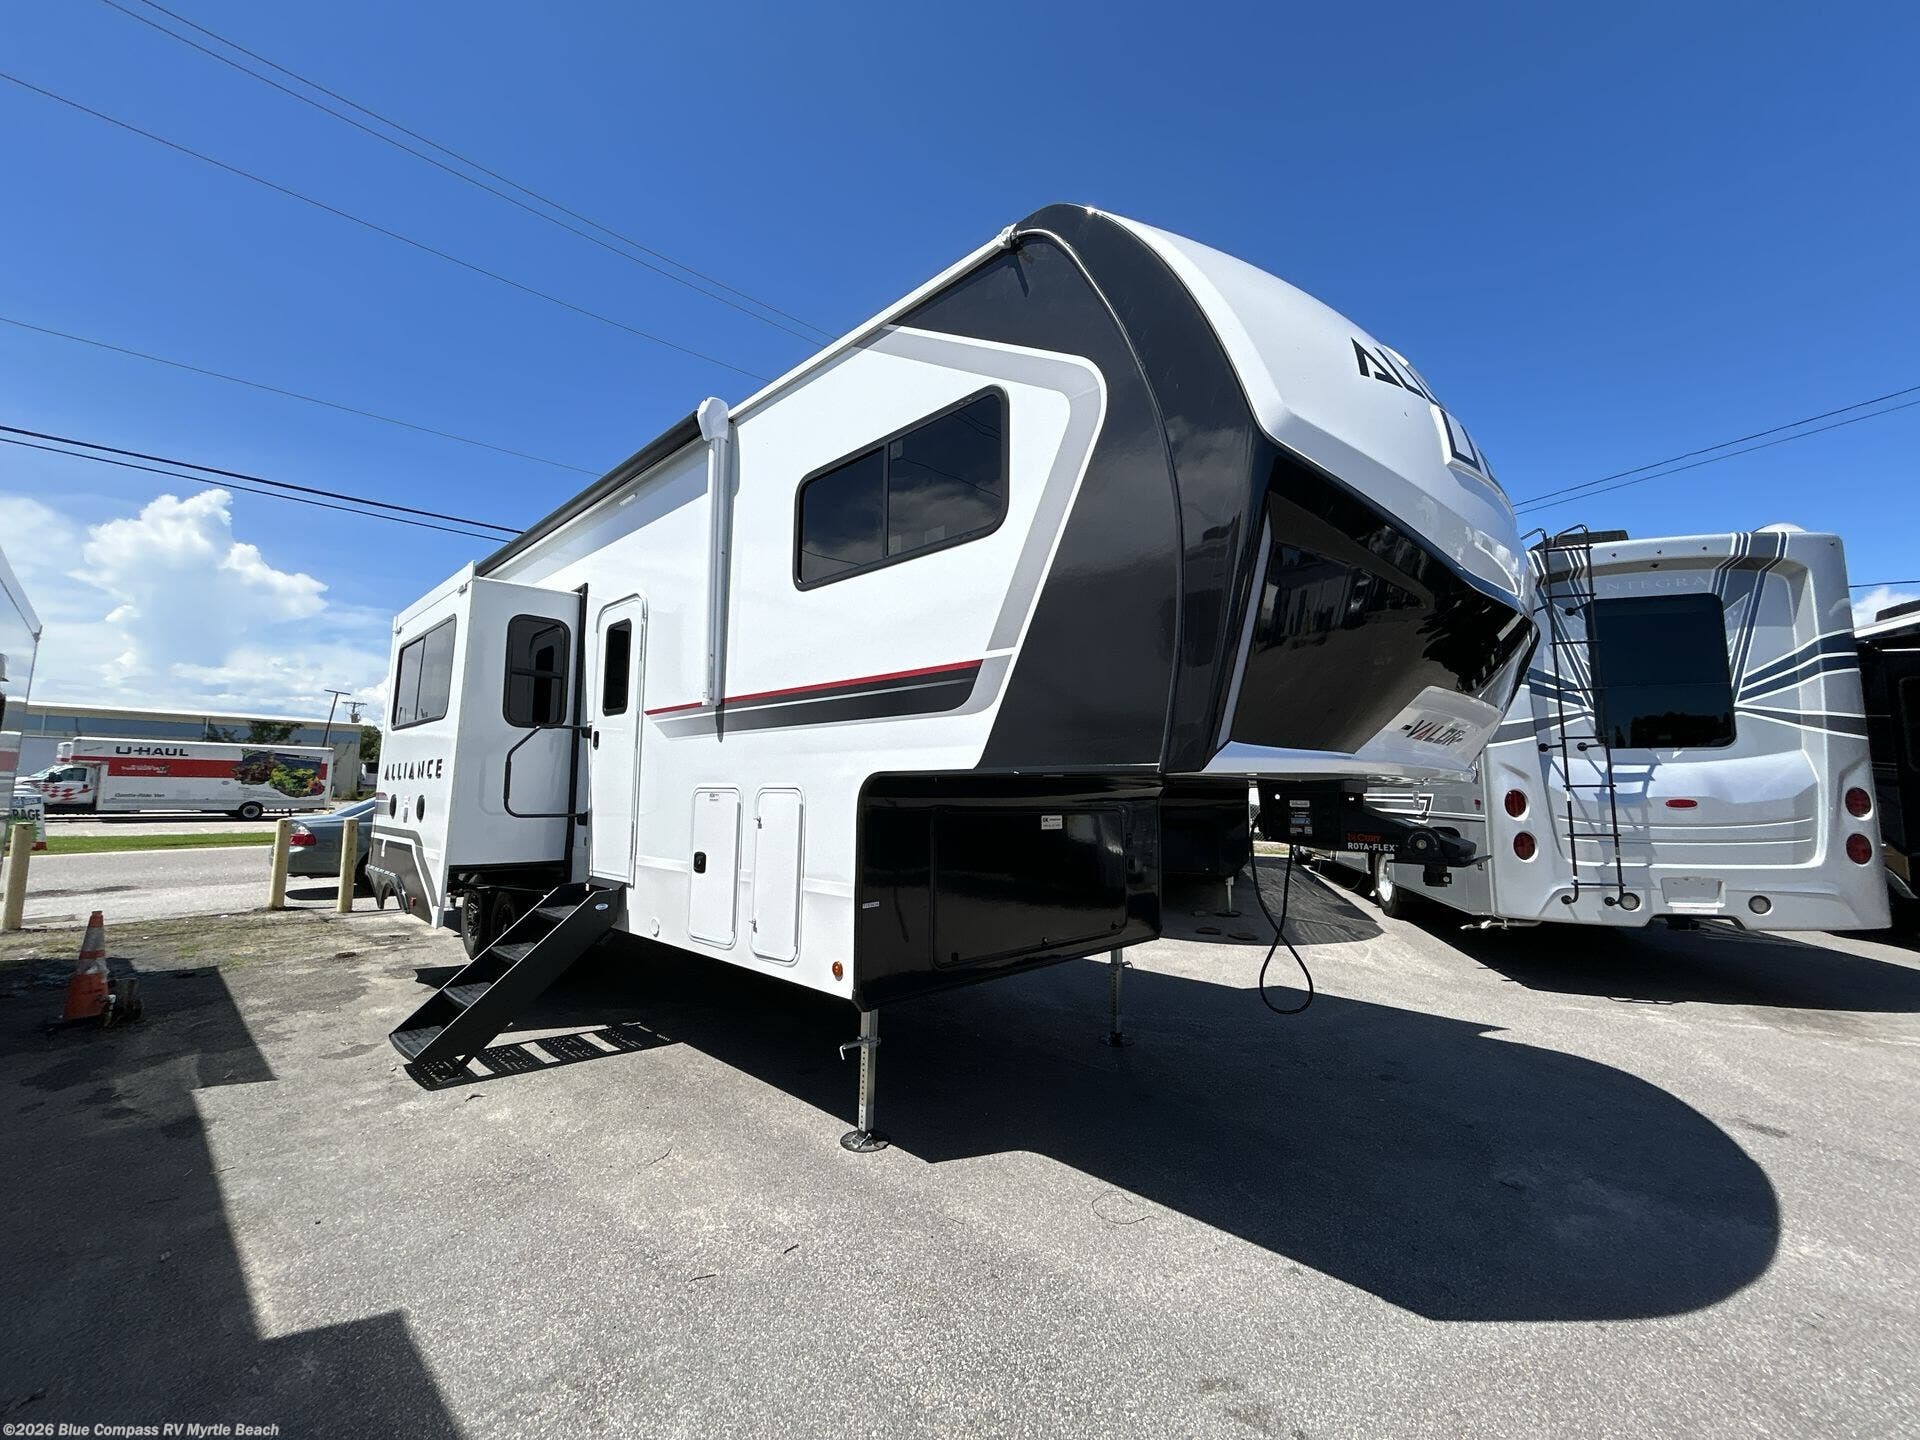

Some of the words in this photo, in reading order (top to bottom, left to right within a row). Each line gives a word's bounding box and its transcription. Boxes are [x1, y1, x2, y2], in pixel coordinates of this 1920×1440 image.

[1592, 576, 1709, 592] NTEGRA
[115, 745, 189, 756] U-HAUL
[384, 758, 443, 781] ALLIANCE
